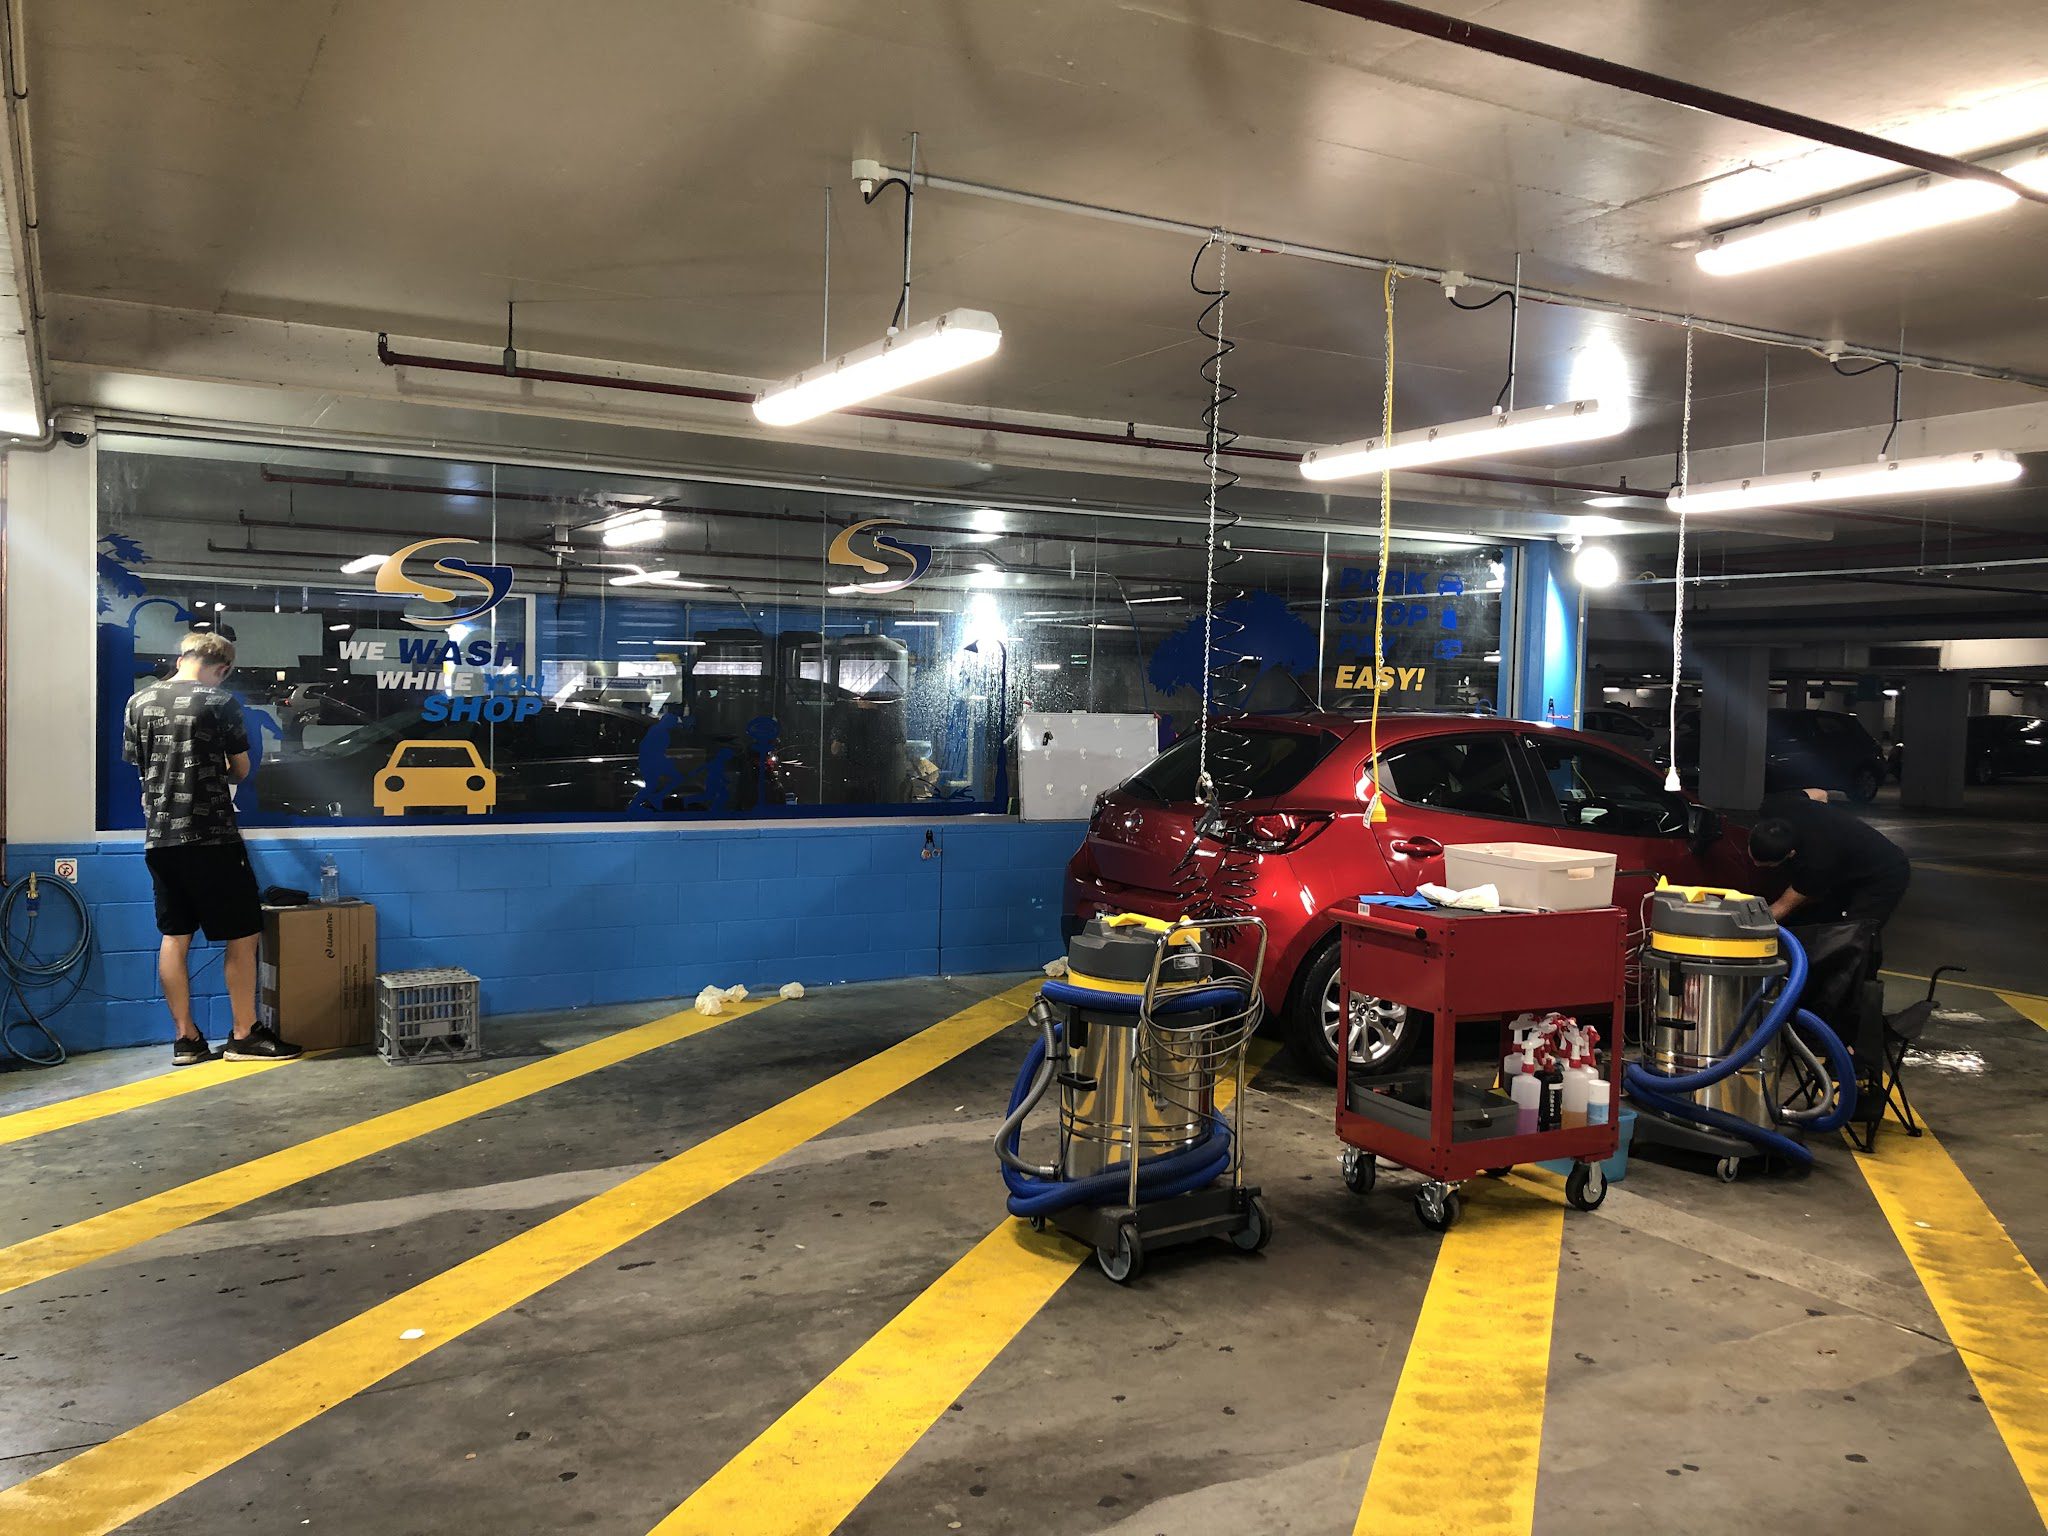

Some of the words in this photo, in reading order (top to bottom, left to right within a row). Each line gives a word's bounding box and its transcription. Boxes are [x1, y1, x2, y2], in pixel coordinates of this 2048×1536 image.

[1340, 568, 1430, 595] PARK
[1339, 601, 1429, 627] SHOP
[339, 641, 387, 660] WE
[399, 638, 527, 666] WASH
[376, 670, 474, 691] WHILE
[484, 674, 545, 696] YOU
[1335, 665, 1426, 691] EASY!
[421, 693, 545, 722] SHOP
